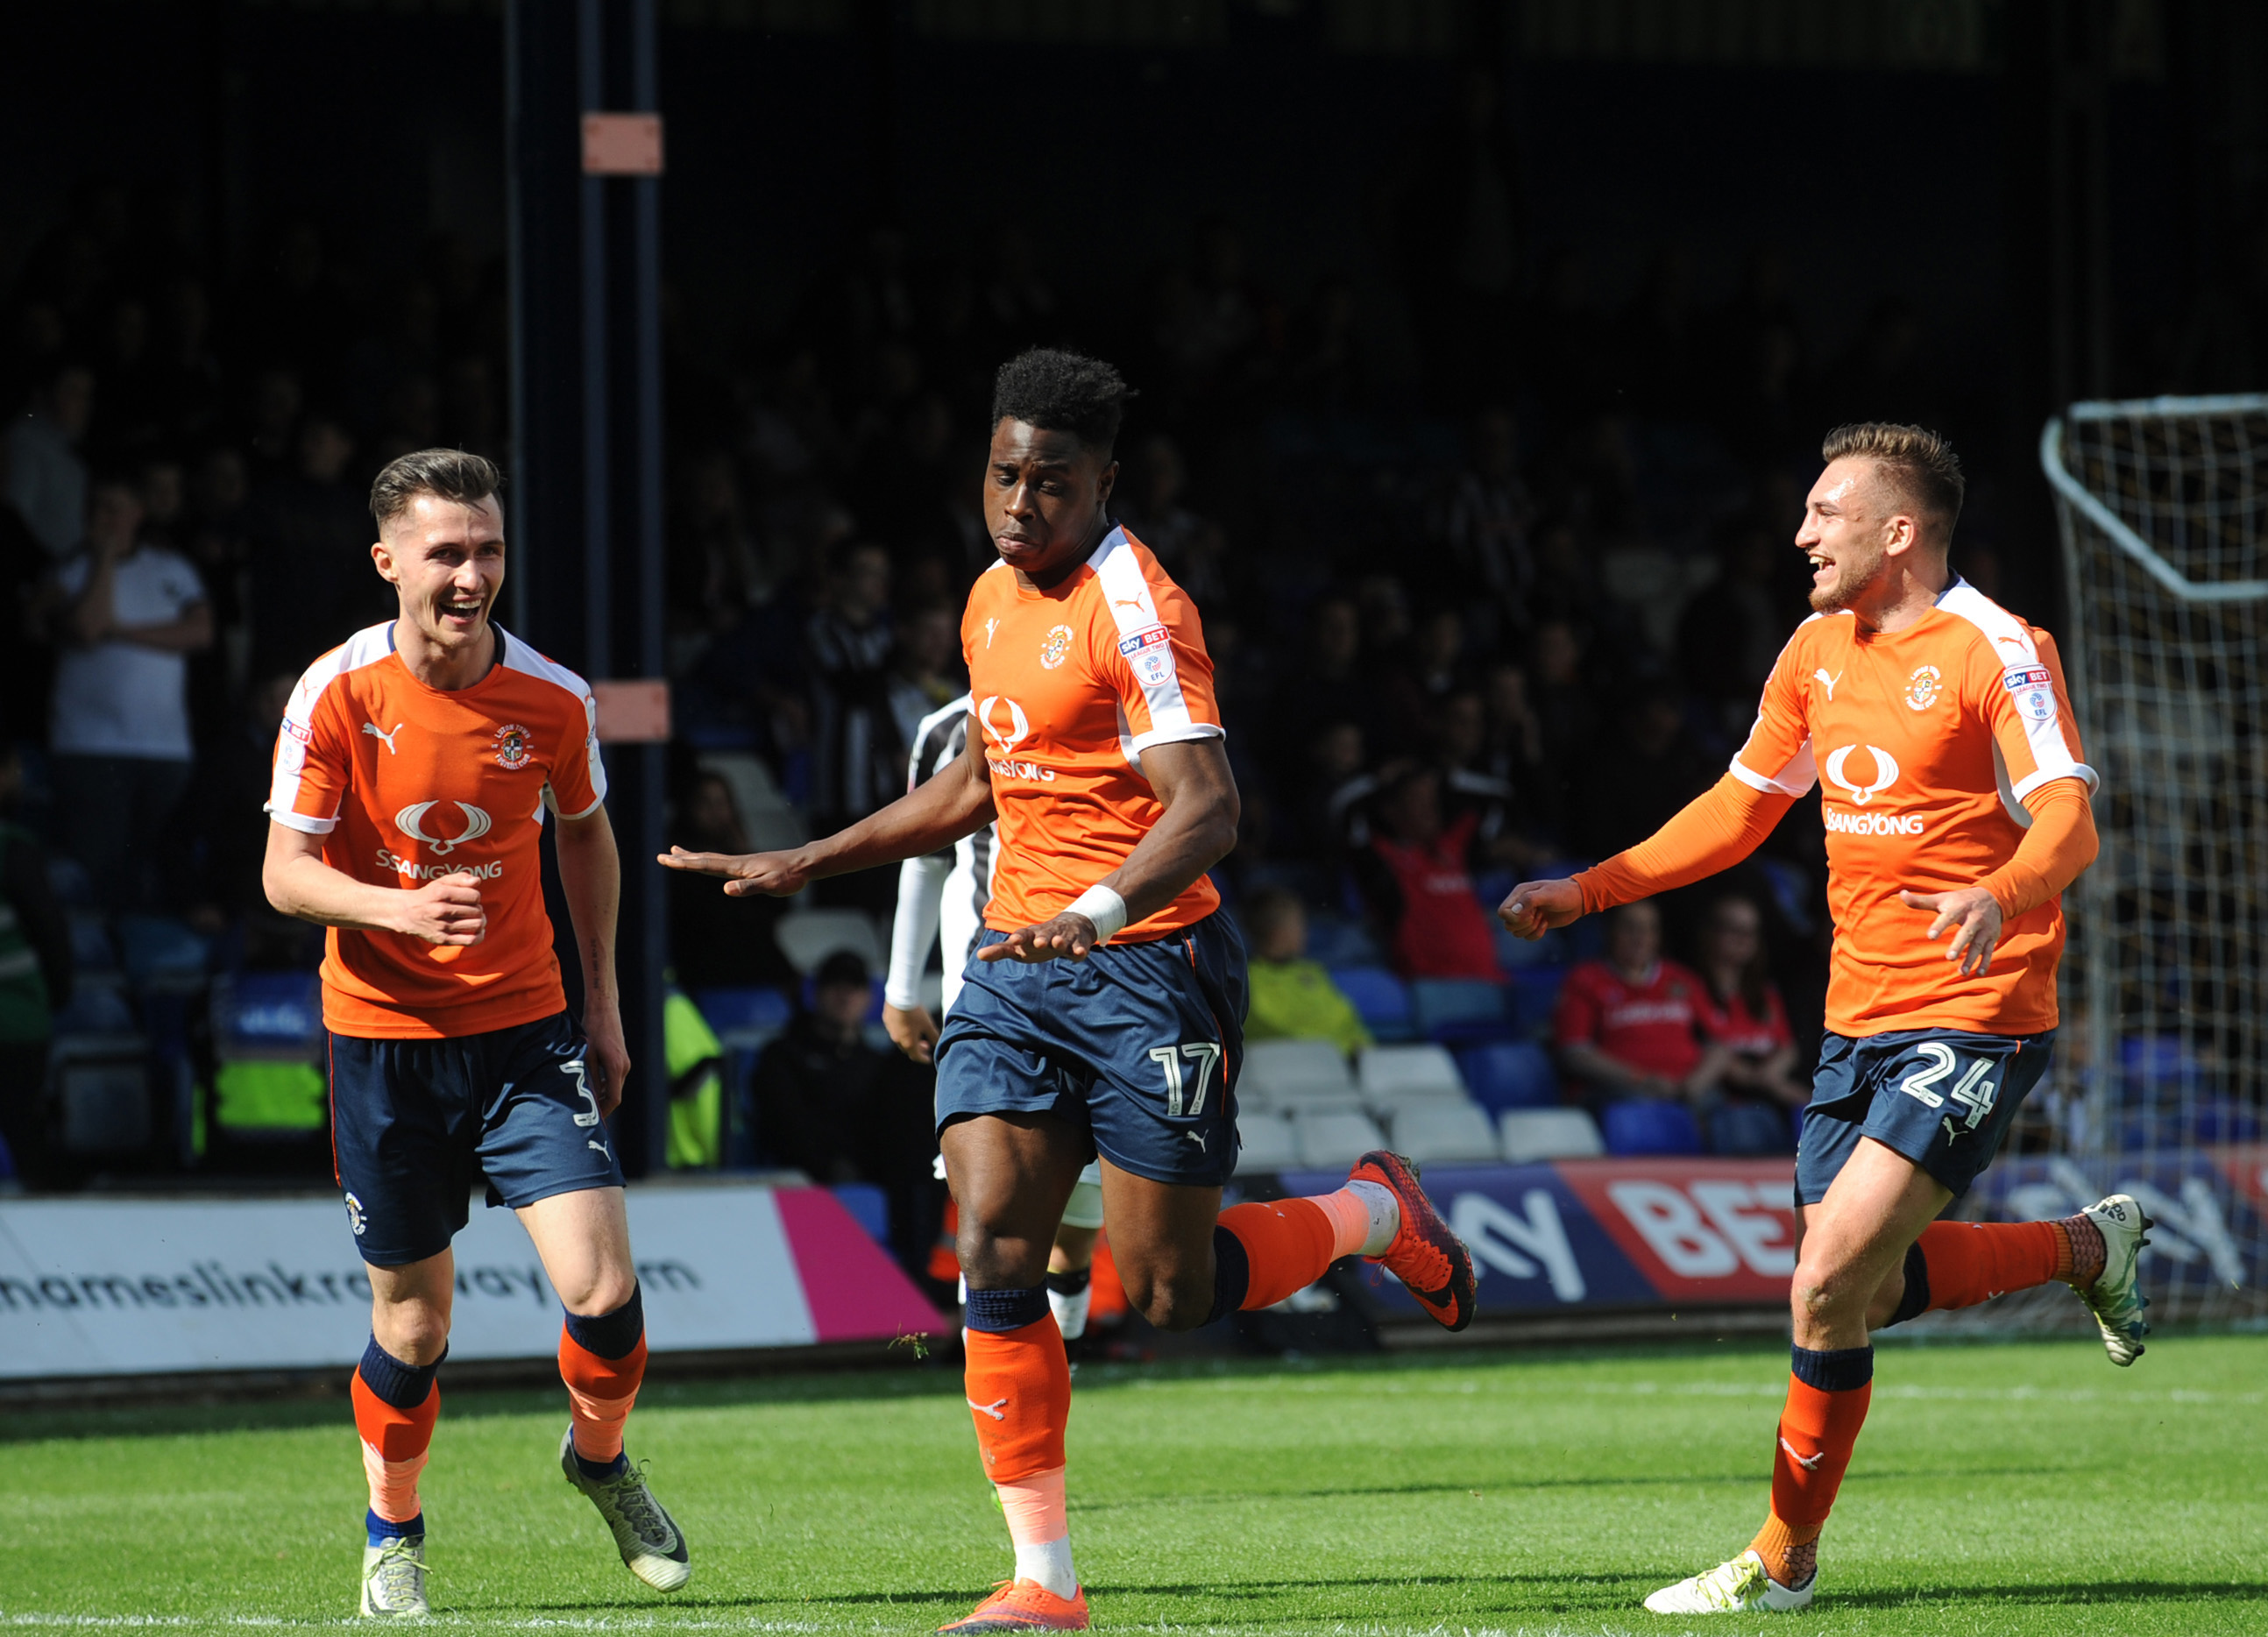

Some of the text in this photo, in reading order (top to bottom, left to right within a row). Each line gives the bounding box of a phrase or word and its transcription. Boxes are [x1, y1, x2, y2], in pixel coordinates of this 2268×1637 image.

[1144, 629, 1165, 644] BET
[1151, 671, 1165, 681] EFL
[2029, 671, 2048, 682] BET
[1825, 807, 1924, 835] SSANGYONG
[1149, 1042, 1221, 1116] 17
[1899, 1042, 1996, 1130] 24
[558, 1059, 600, 1128] 3
